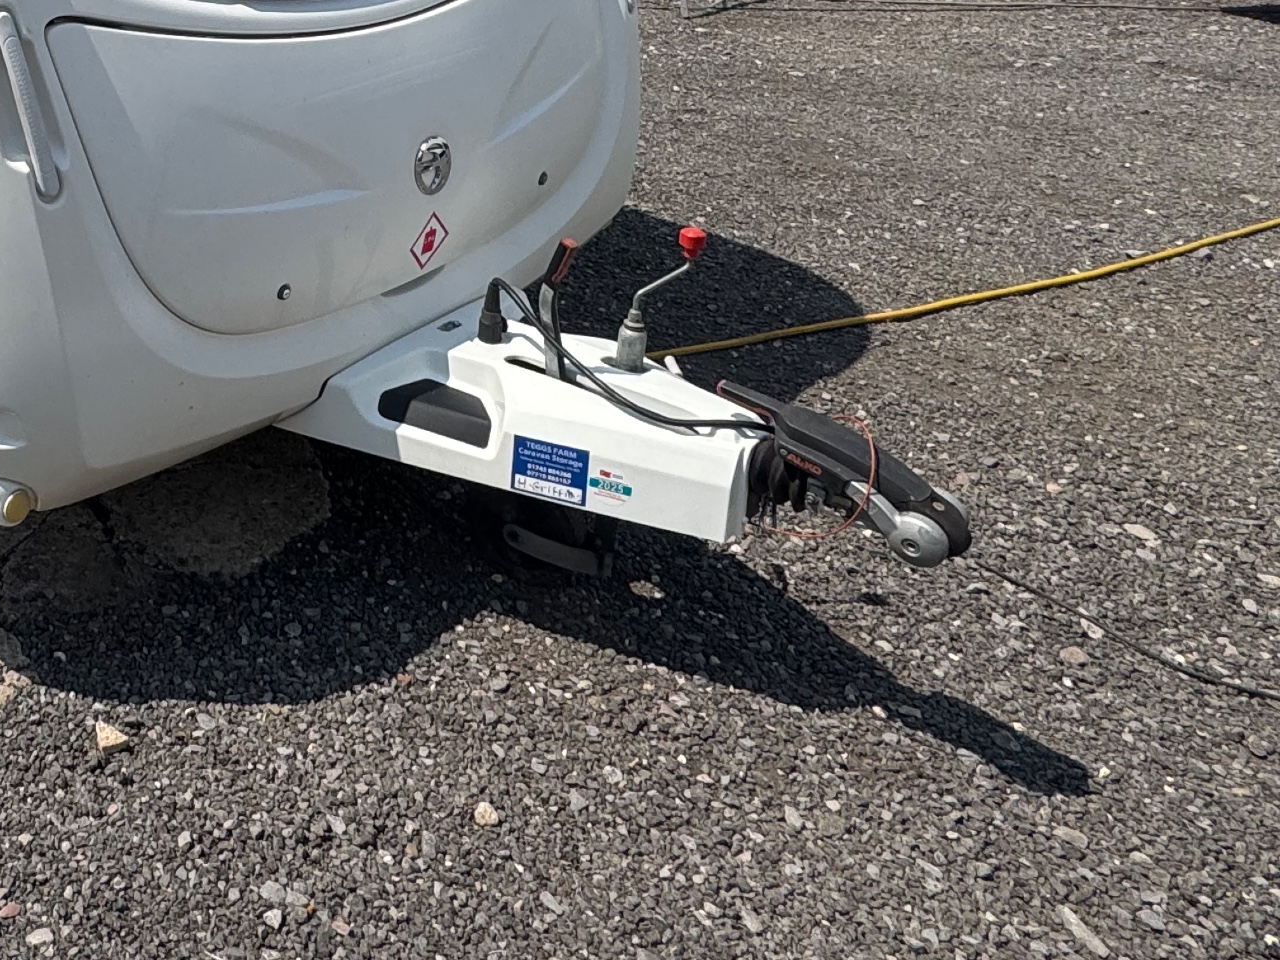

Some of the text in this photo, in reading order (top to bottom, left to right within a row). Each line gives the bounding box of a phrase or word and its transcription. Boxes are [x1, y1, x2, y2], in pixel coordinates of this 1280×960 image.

[518, 446, 550, 460] Caravan
[551, 455, 583, 468] Storage
[553, 447, 577, 459] FARM
[598, 481, 624, 494] 2025
